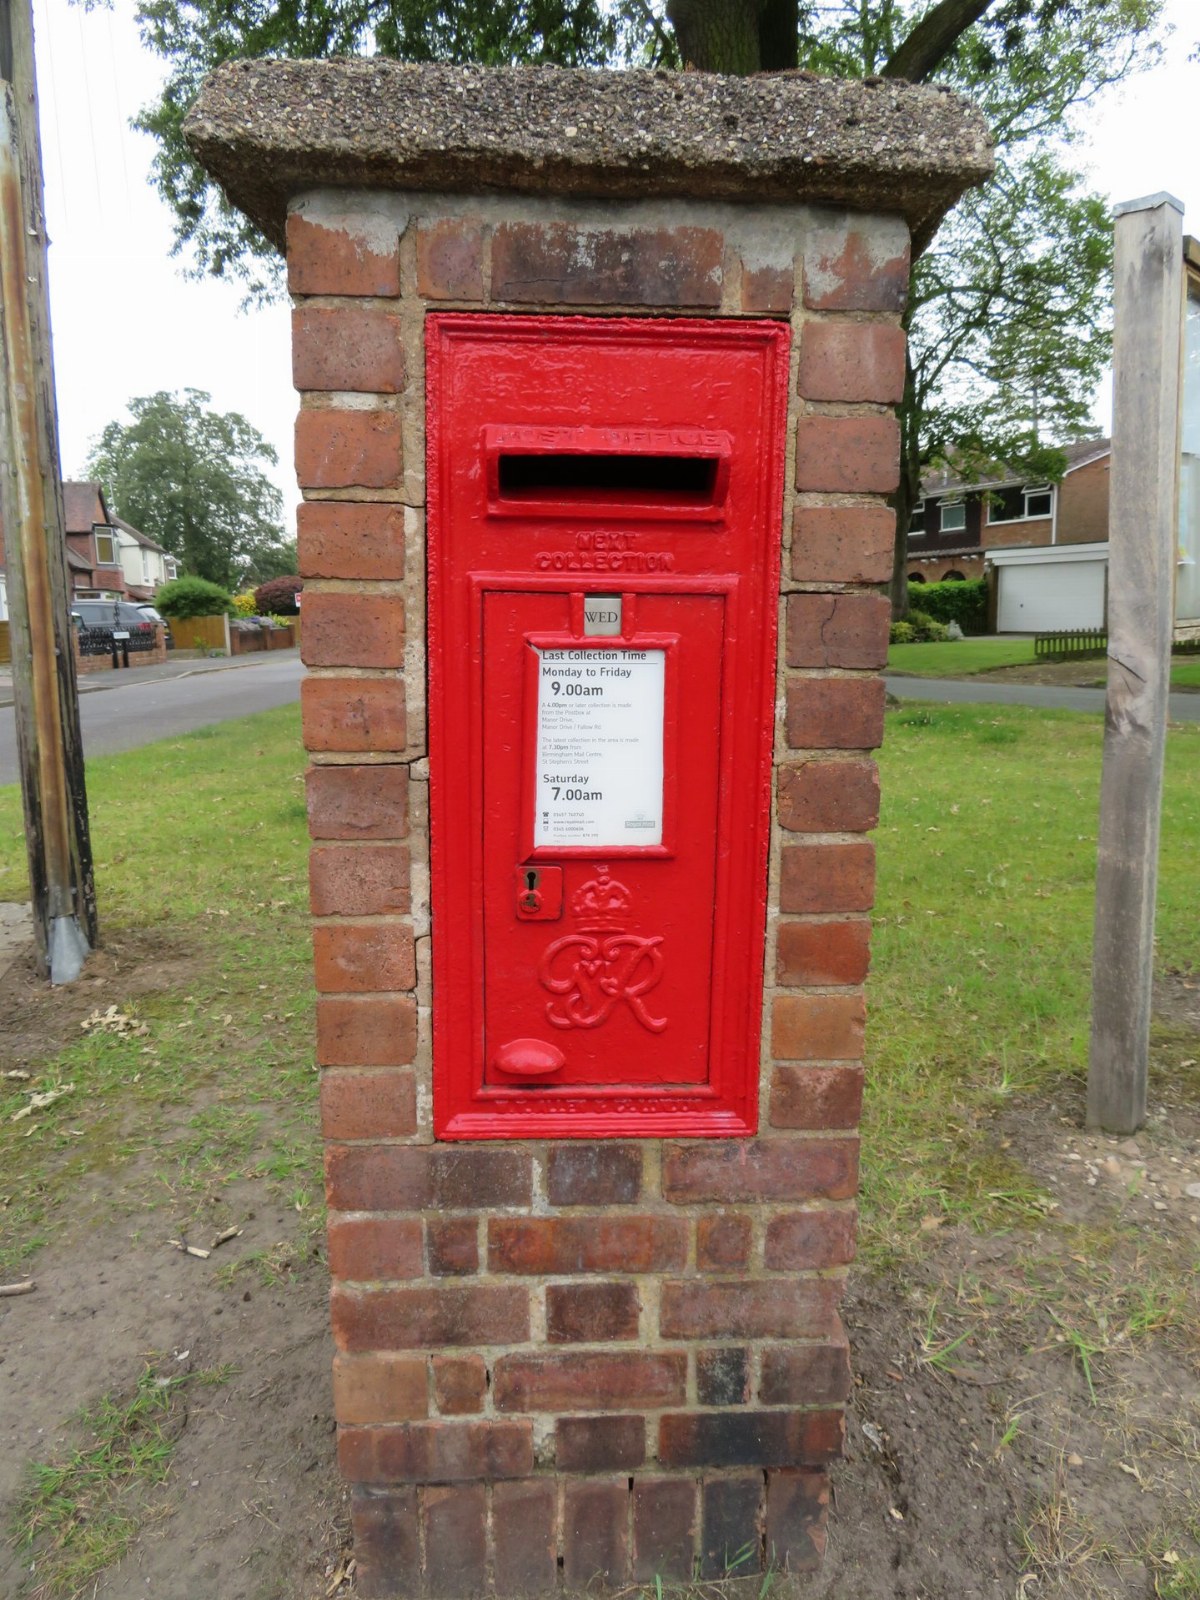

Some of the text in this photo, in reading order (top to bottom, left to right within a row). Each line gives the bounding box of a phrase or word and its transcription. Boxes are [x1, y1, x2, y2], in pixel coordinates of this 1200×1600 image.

[575, 531, 641, 550] NEXT
[535, 552, 675, 571] COLLECTION
[584, 611, 618, 623] WED
[542, 651, 646, 660] Last Collection Time
[542, 667, 632, 678] Monday to Friday
[551, 681, 603, 696] 9.00am
[543, 774, 589, 784] Saturday
[551, 787, 602, 801] 7.00am
